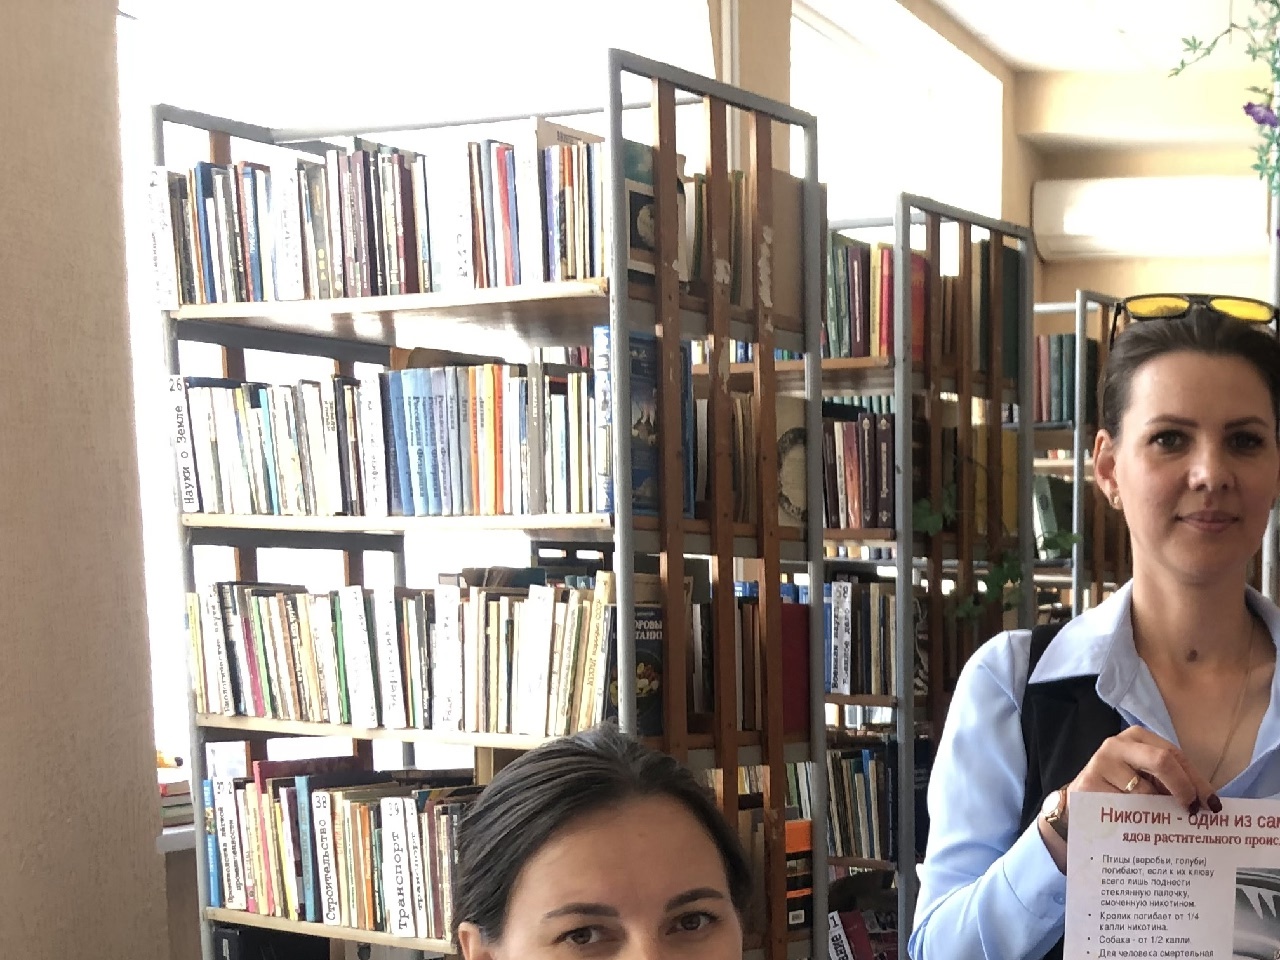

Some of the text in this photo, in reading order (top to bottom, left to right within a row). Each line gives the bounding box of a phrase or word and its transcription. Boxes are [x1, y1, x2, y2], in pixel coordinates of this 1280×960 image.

[175, 405, 195, 504] Науки о Земле
[1101, 807, 1171, 825] Никотин
[1188, 810, 1229, 830] один
[1234, 815, 1252, 828] из
[1122, 831, 1151, 844] ядов
[1154, 832, 1242, 846] растительного
[319, 819, 337, 921] Строительство
[391, 831, 409, 930] Транспорт
